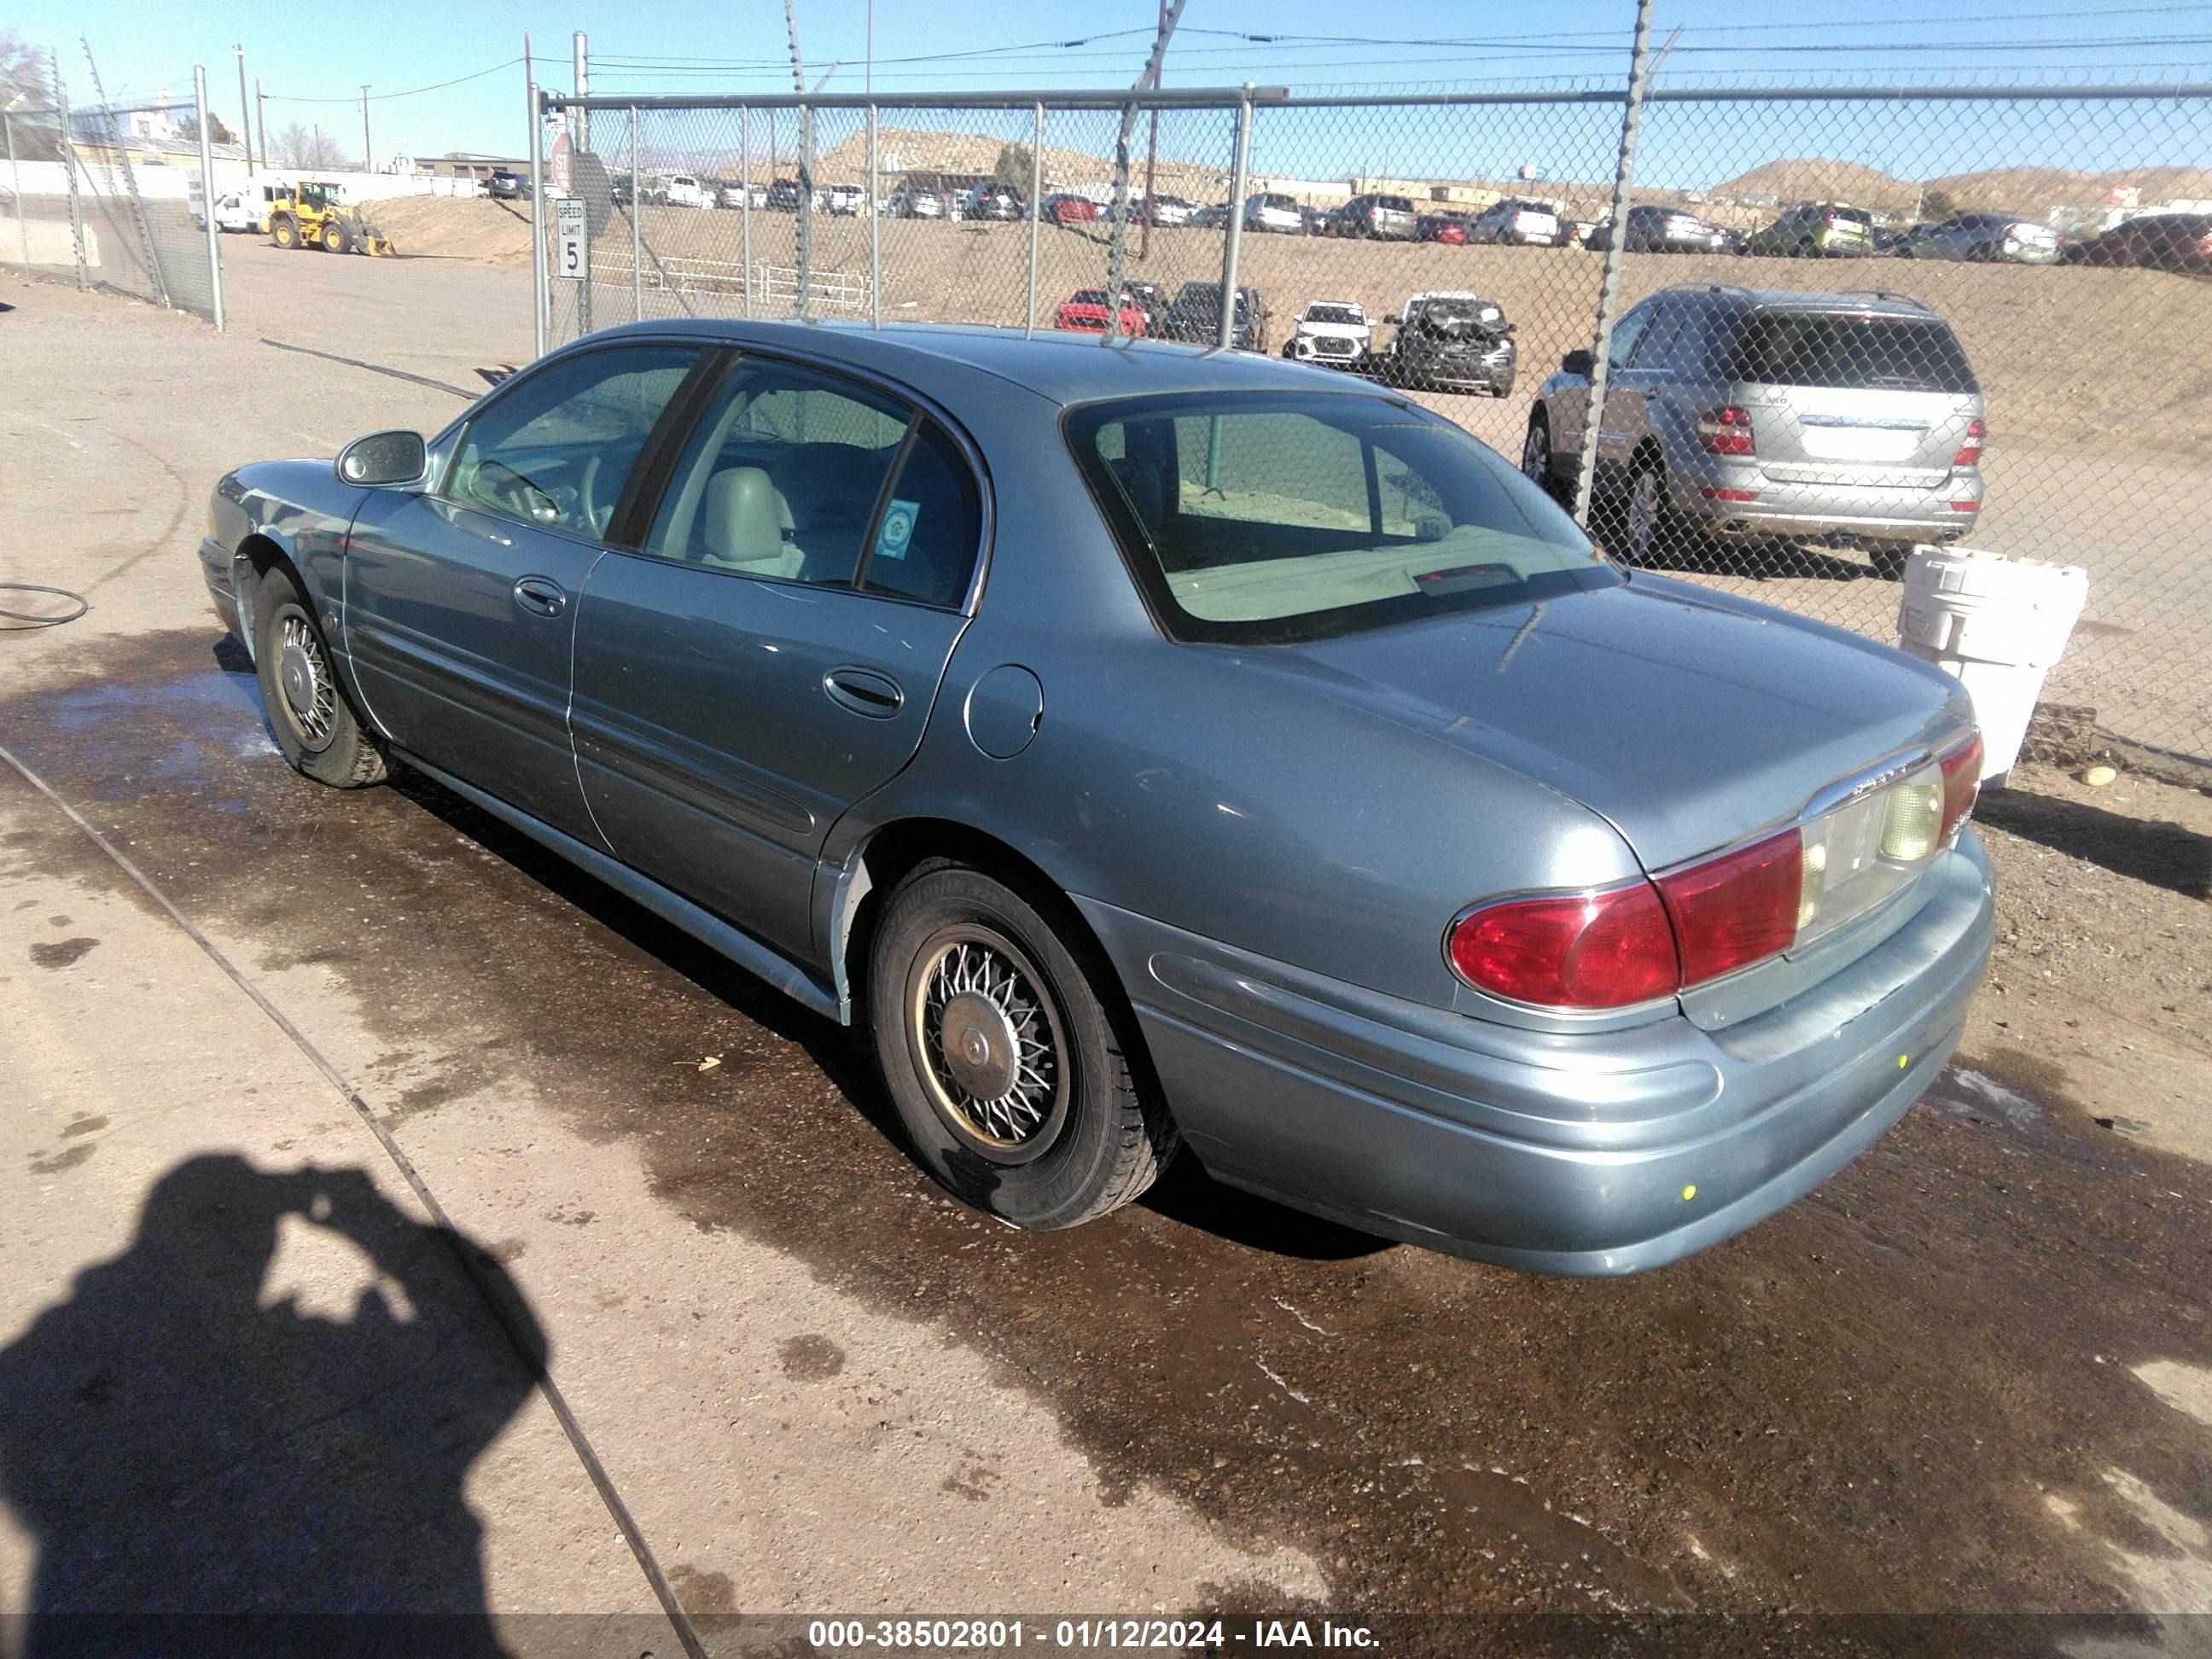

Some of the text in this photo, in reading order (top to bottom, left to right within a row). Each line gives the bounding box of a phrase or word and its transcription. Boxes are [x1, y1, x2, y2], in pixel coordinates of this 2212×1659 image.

[559, 207, 582, 218] SPEED
[562, 224, 580, 236] LIMIT
[567, 242, 578, 271] 5
